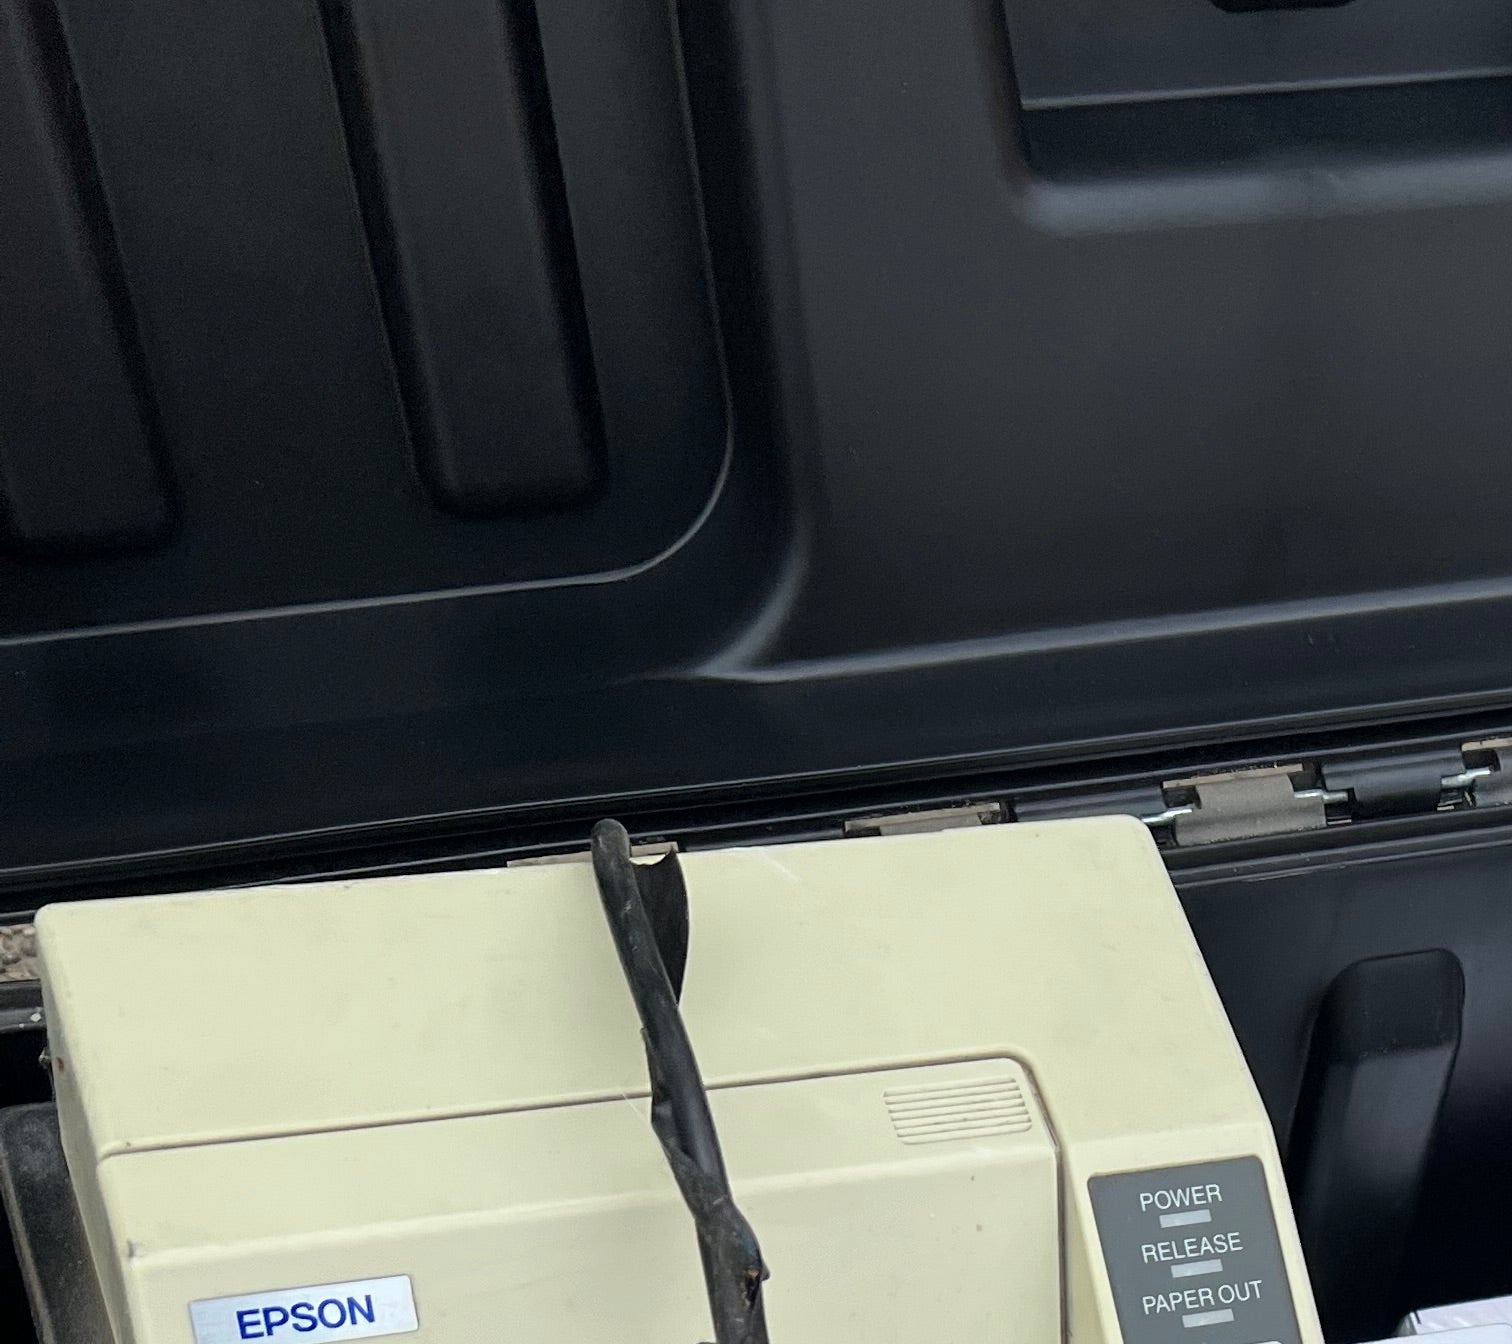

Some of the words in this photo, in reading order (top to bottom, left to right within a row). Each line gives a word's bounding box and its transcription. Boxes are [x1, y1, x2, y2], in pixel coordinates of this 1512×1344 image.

[1139, 1184, 1223, 1213] POWER
[1141, 1232, 1243, 1265] RELEASE
[1142, 1286, 1216, 1317] PAPER
[1218, 1280, 1263, 1307] OUT
[236, 1294, 376, 1341] EPSON
